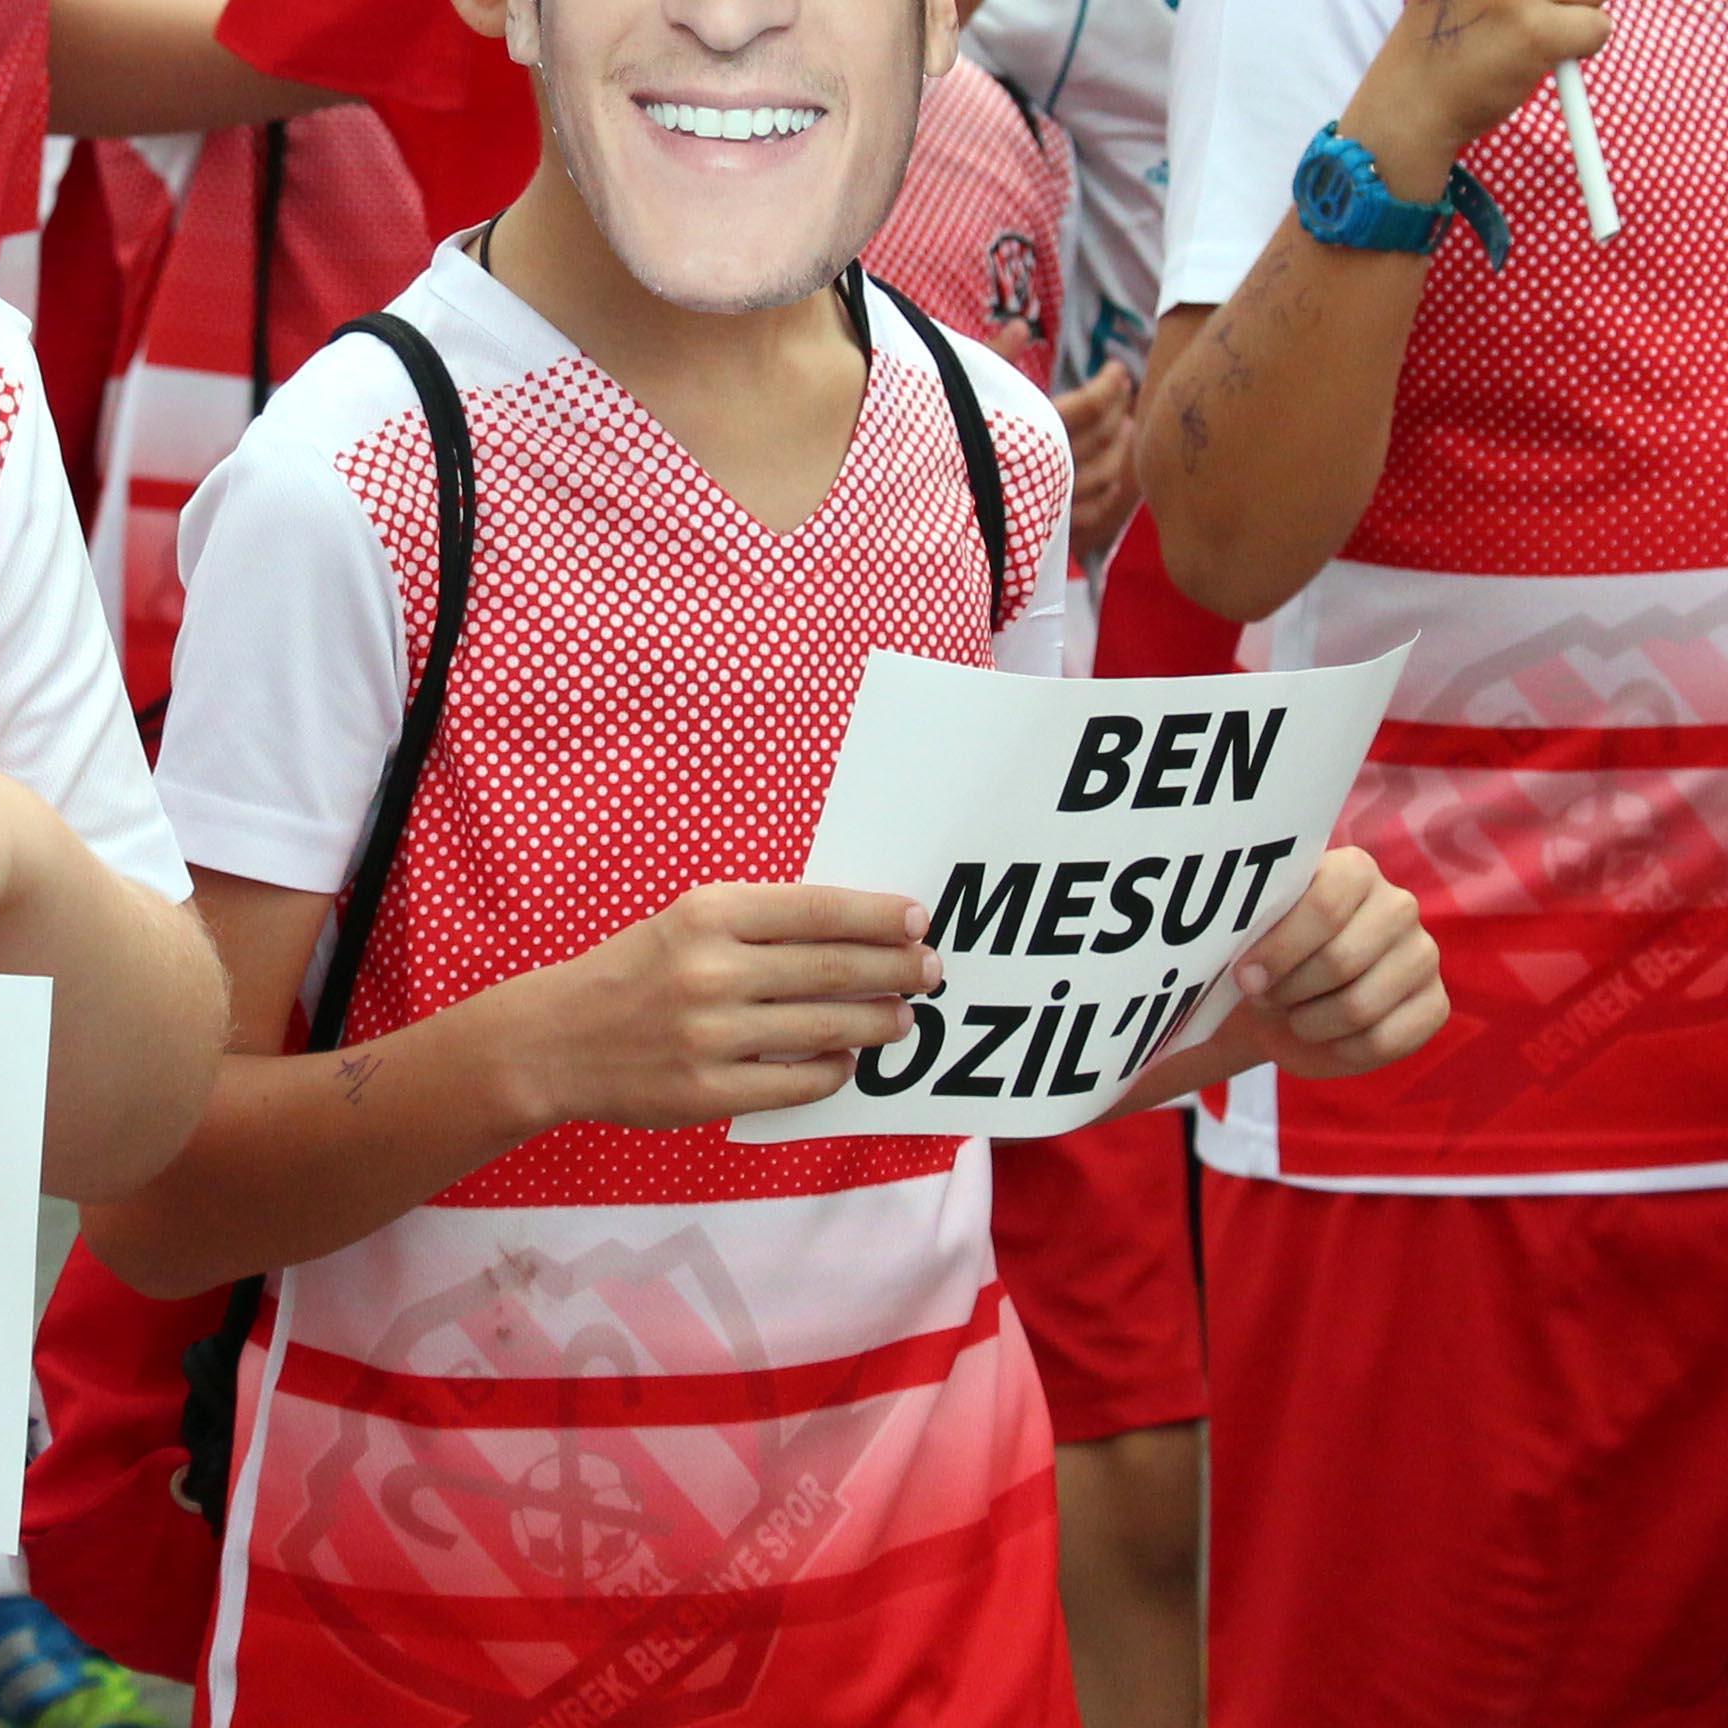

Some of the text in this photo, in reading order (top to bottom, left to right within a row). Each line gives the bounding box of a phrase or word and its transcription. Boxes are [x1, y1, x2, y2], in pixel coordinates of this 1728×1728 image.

[1056, 706, 1288, 813] BEN
[921, 835, 1298, 956] MESUT
[757, 1470, 829, 1564] SPOR
